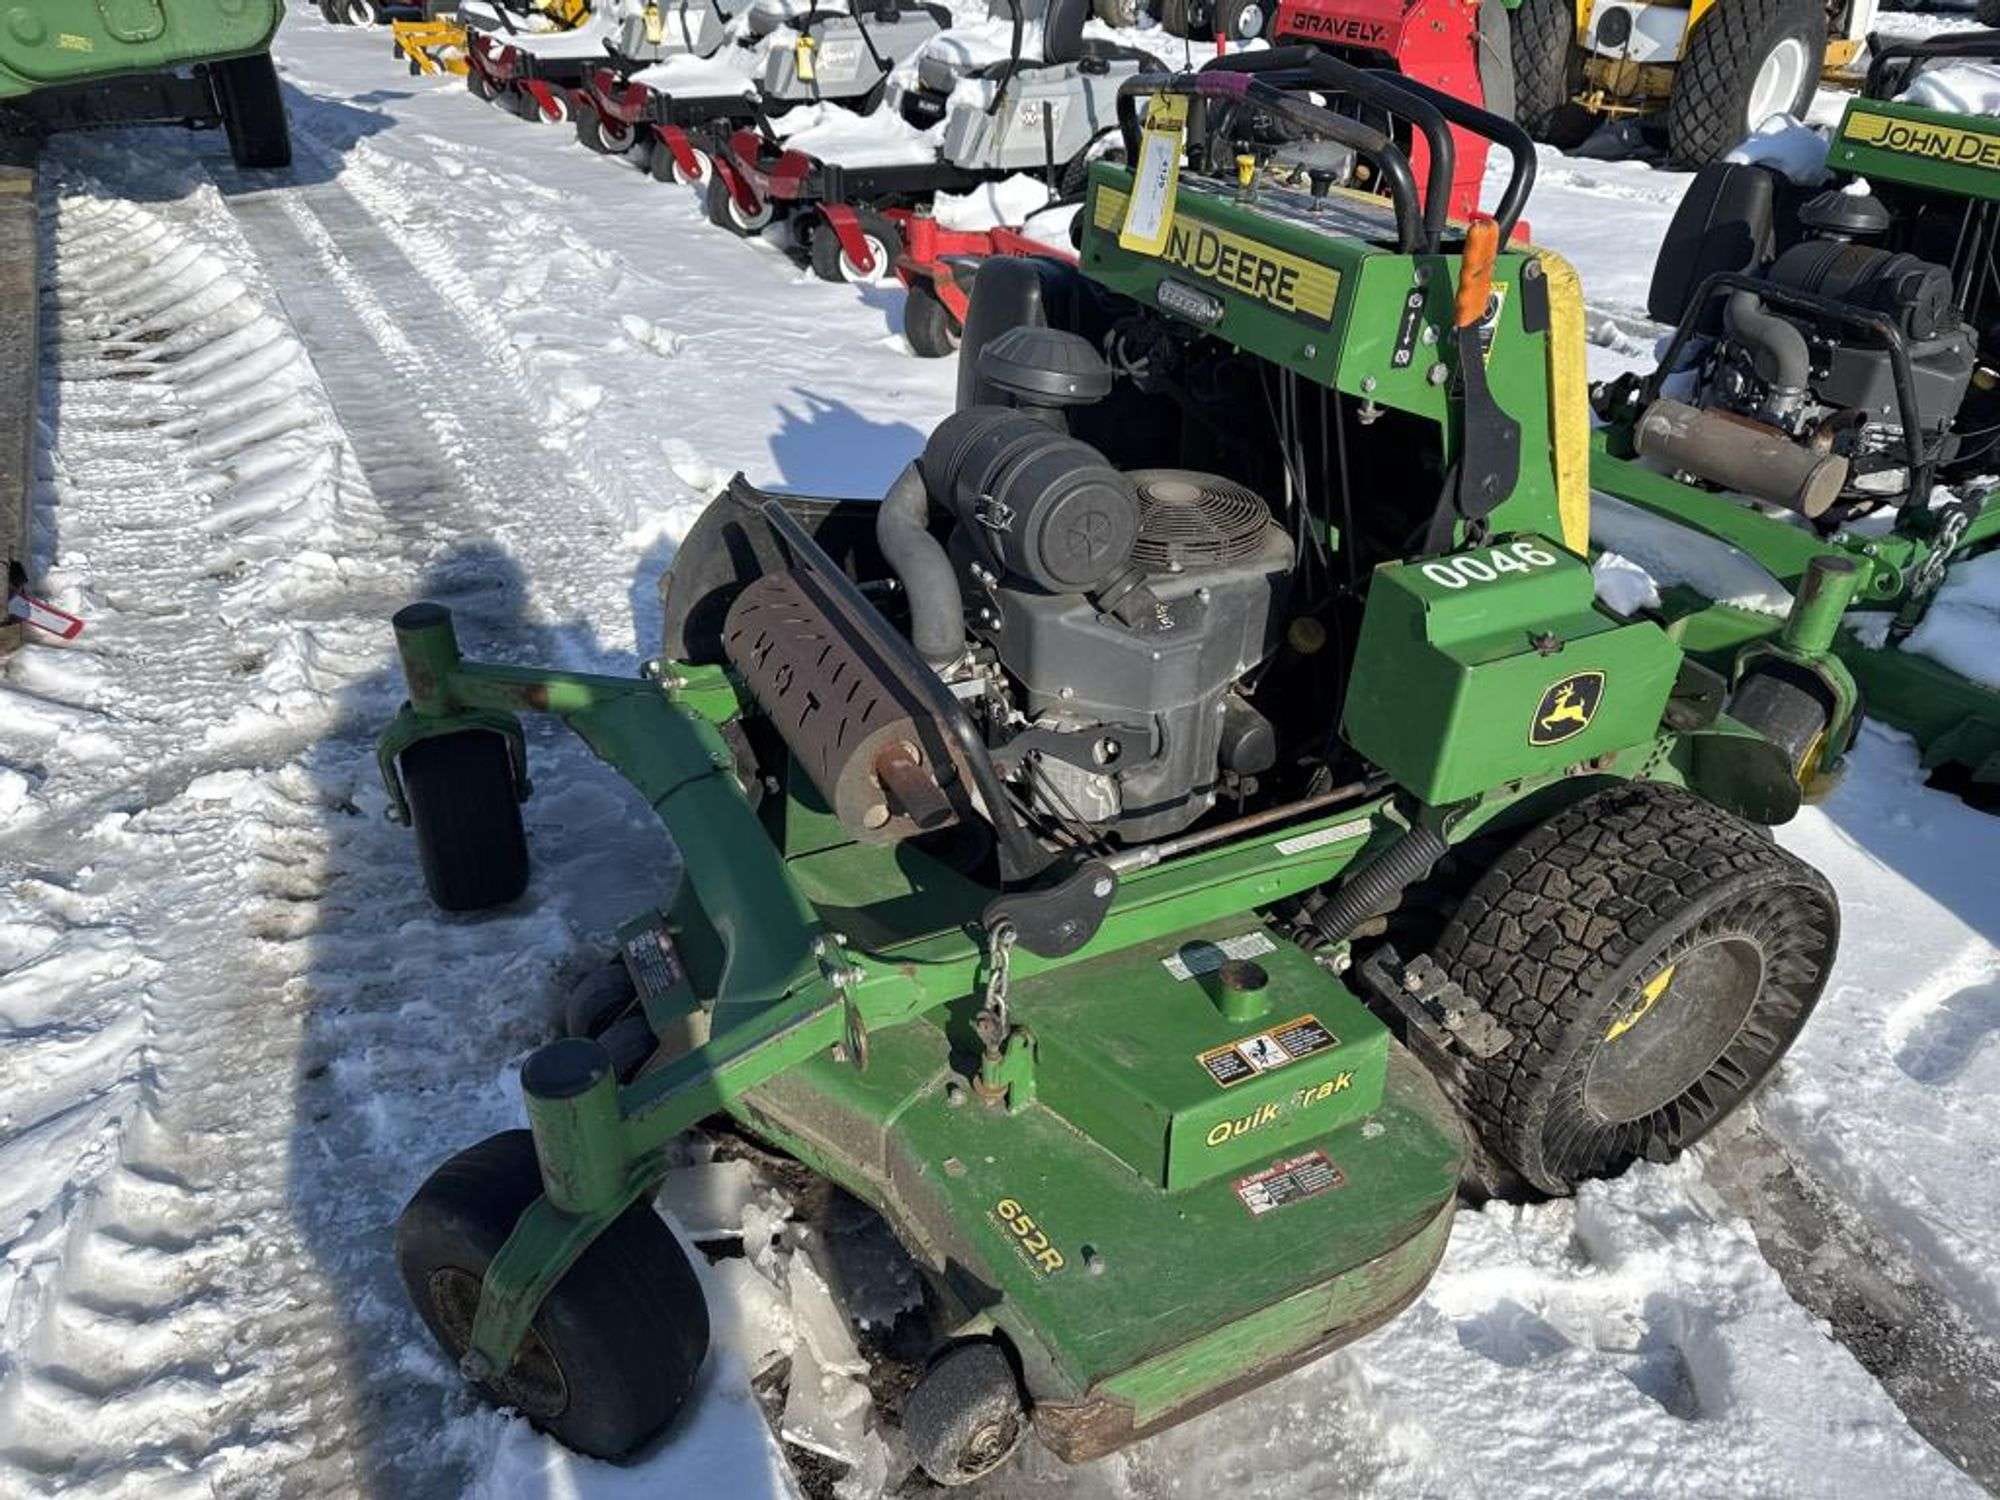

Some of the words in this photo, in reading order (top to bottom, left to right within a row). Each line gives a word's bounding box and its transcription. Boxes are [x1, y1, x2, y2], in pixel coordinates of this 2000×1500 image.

[1294, 12, 1384, 42] GRAVELY
[1870, 121, 1952, 158] JOHN
[1955, 134, 2000, 167] DE
[1194, 226, 1300, 308] DEERE
[1422, 542, 1557, 588] 0046
[998, 1198, 1064, 1274] 652R
